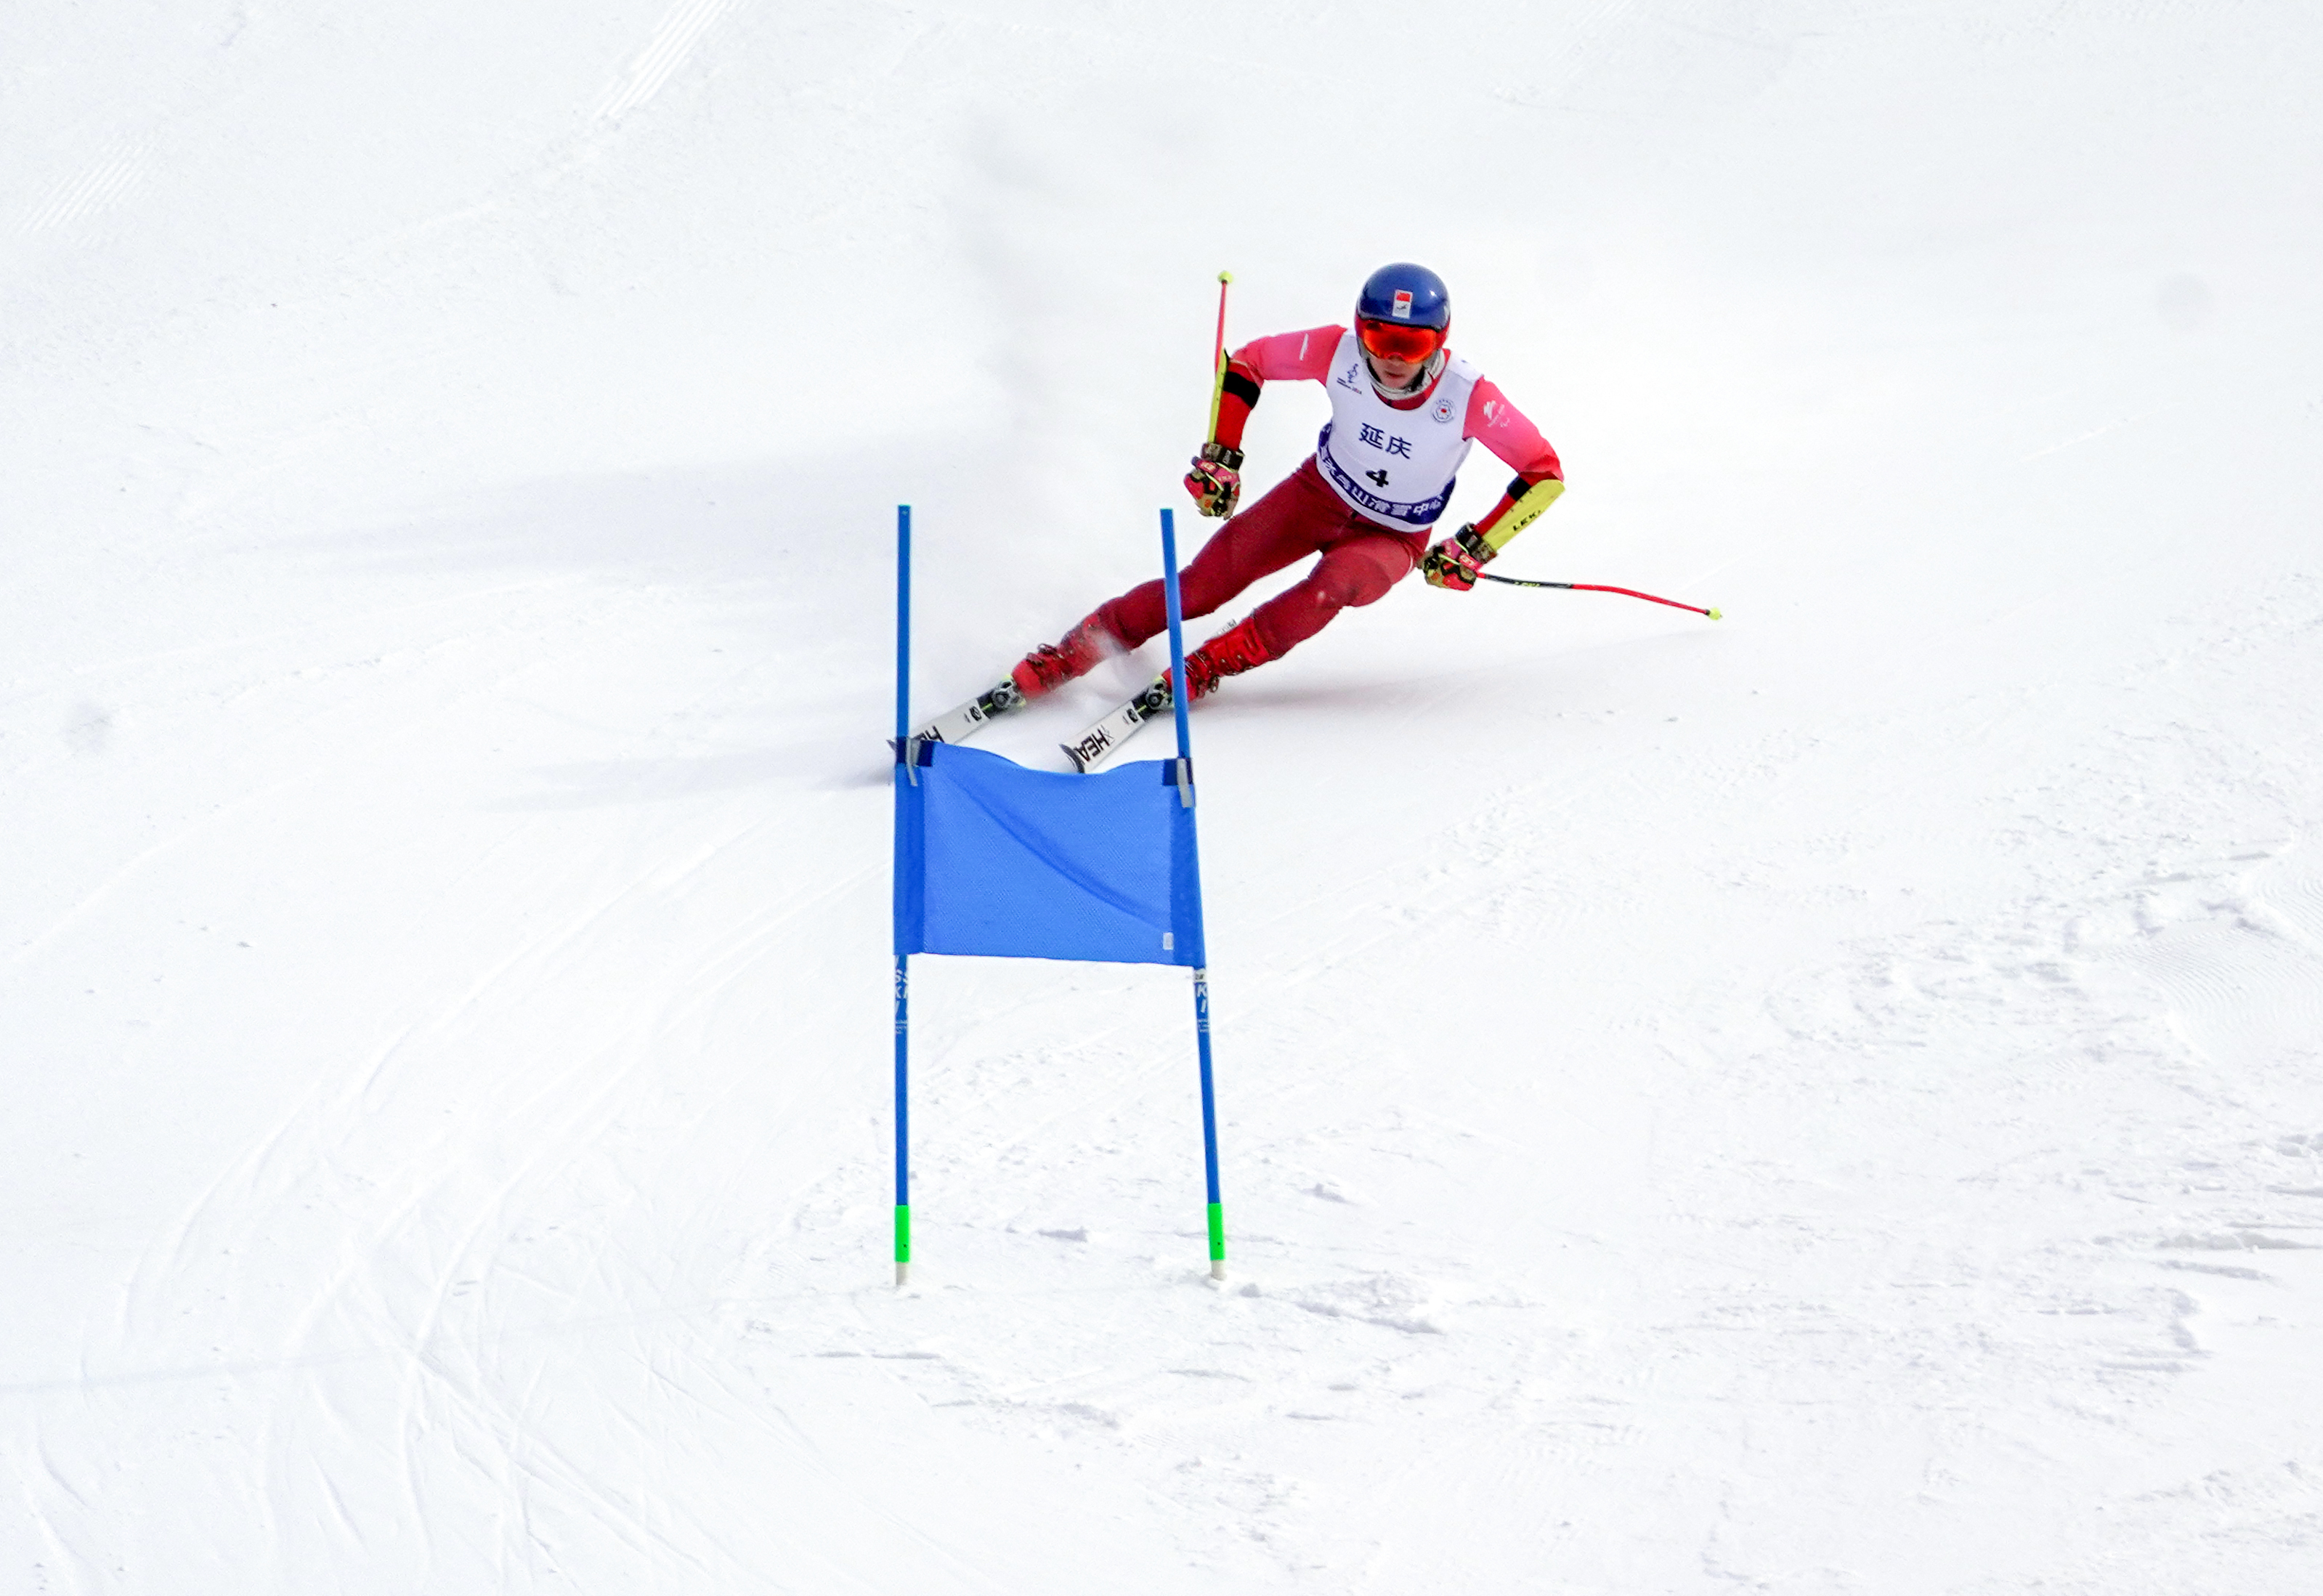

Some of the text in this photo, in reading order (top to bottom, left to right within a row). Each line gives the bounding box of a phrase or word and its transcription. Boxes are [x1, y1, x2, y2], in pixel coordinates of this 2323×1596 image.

[1358, 422, 1413, 460] 延庆
[1366, 469, 1389, 487] 4
[1073, 729, 1111, 765] HEA
